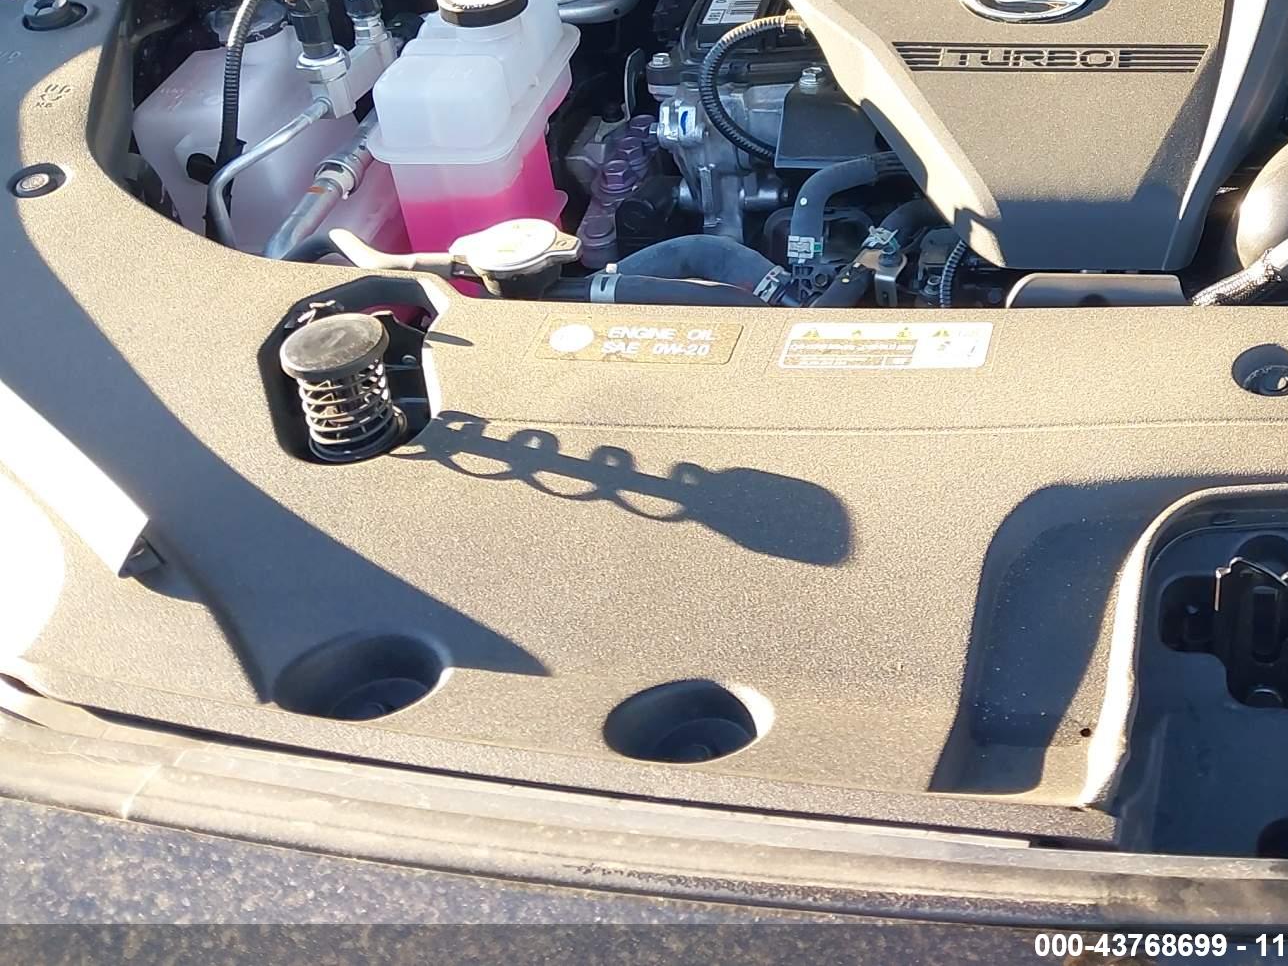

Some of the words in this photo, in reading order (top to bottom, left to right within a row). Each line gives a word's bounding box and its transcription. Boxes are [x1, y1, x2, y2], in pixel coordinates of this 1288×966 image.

[947, 49, 1116, 68] TURBO
[607, 326, 678, 339] ENGINE
[687, 328, 716, 341] OIL
[601, 341, 641, 354] SAE
[653, 343, 711, 356] 0W-20
